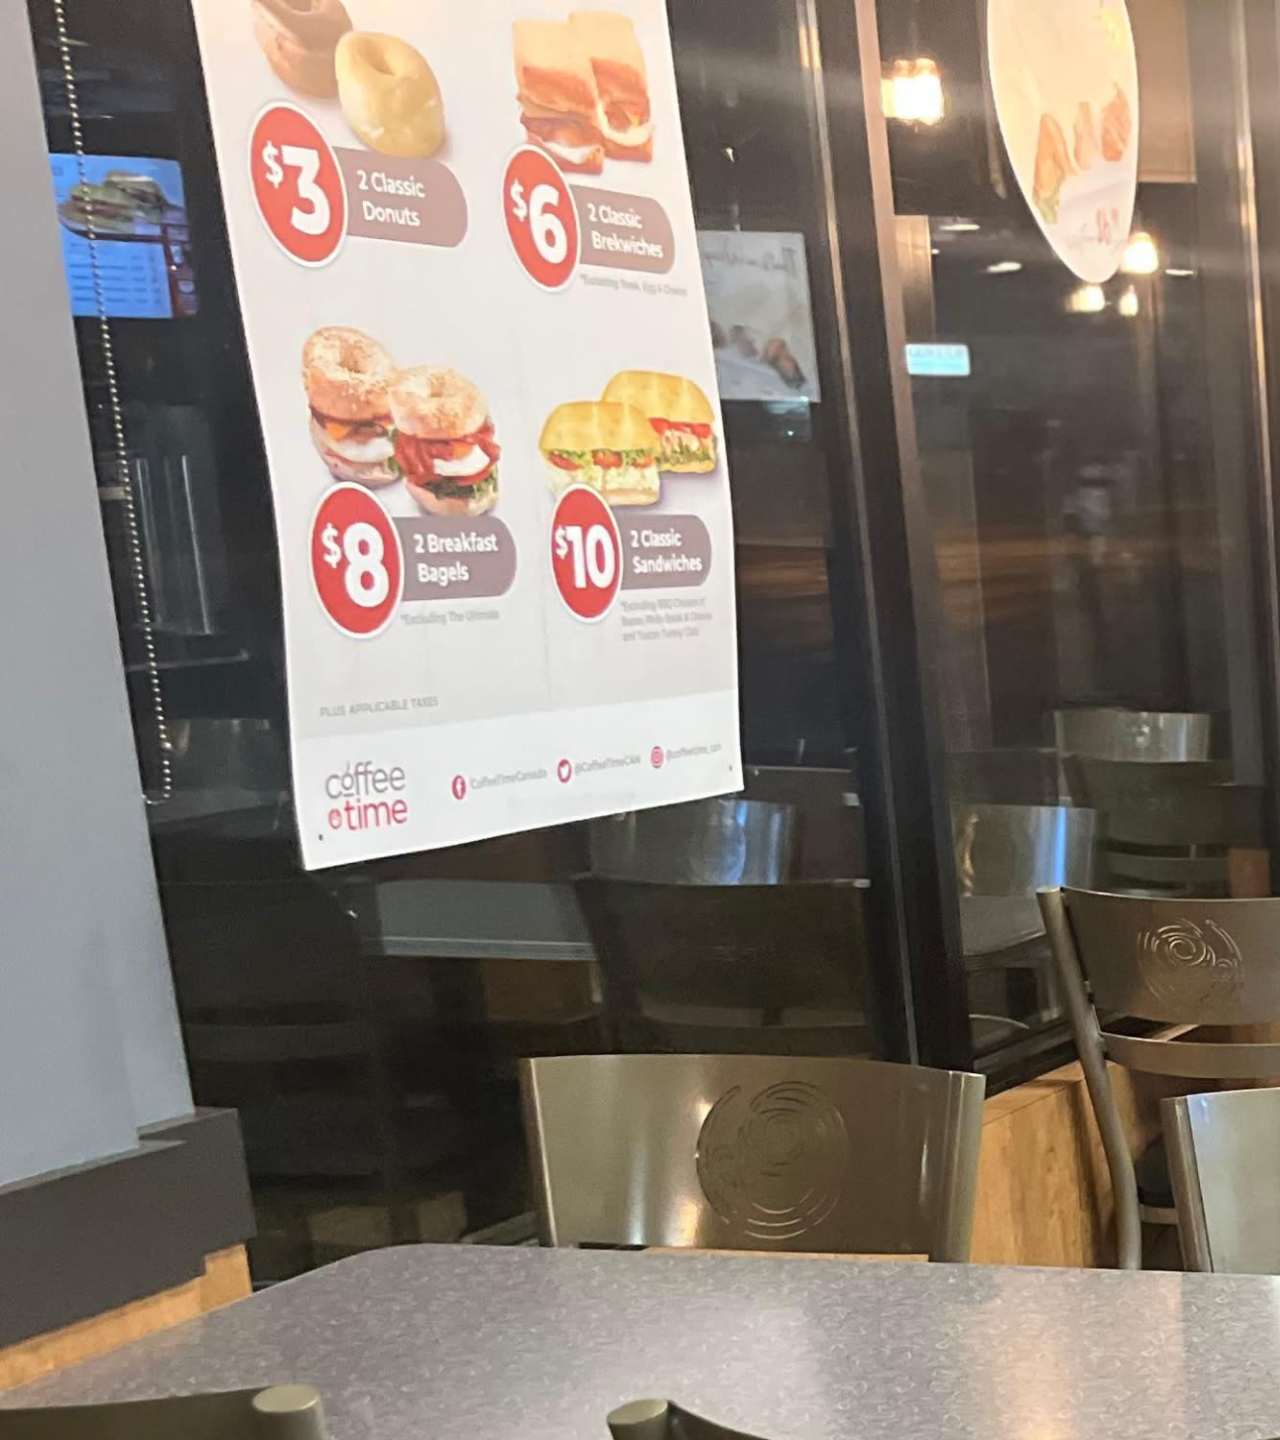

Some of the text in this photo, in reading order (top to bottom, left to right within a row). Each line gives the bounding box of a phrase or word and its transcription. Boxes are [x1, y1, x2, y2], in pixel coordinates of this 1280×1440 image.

[262, 141, 331, 235] $3
[356, 170, 426, 199] 2 Classic
[362, 201, 421, 227] Donuts
[510, 178, 567, 264] $6
[587, 203, 643, 229] 2 Classic
[591, 231, 664, 259] Brekwiches
[413, 531, 499, 554] 2 Breakfast
[630, 528, 683, 547] 2 Classic
[321, 523, 390, 608] $8
[555, 524, 616, 589] $10
[633, 553, 703, 574] Sandwiches
[417, 561, 470, 587] Bagels
[319, 696, 439, 717] PLUS APPLICABLE TAXES
[325, 760, 406, 799] coffee
[344, 797, 408, 831] time
